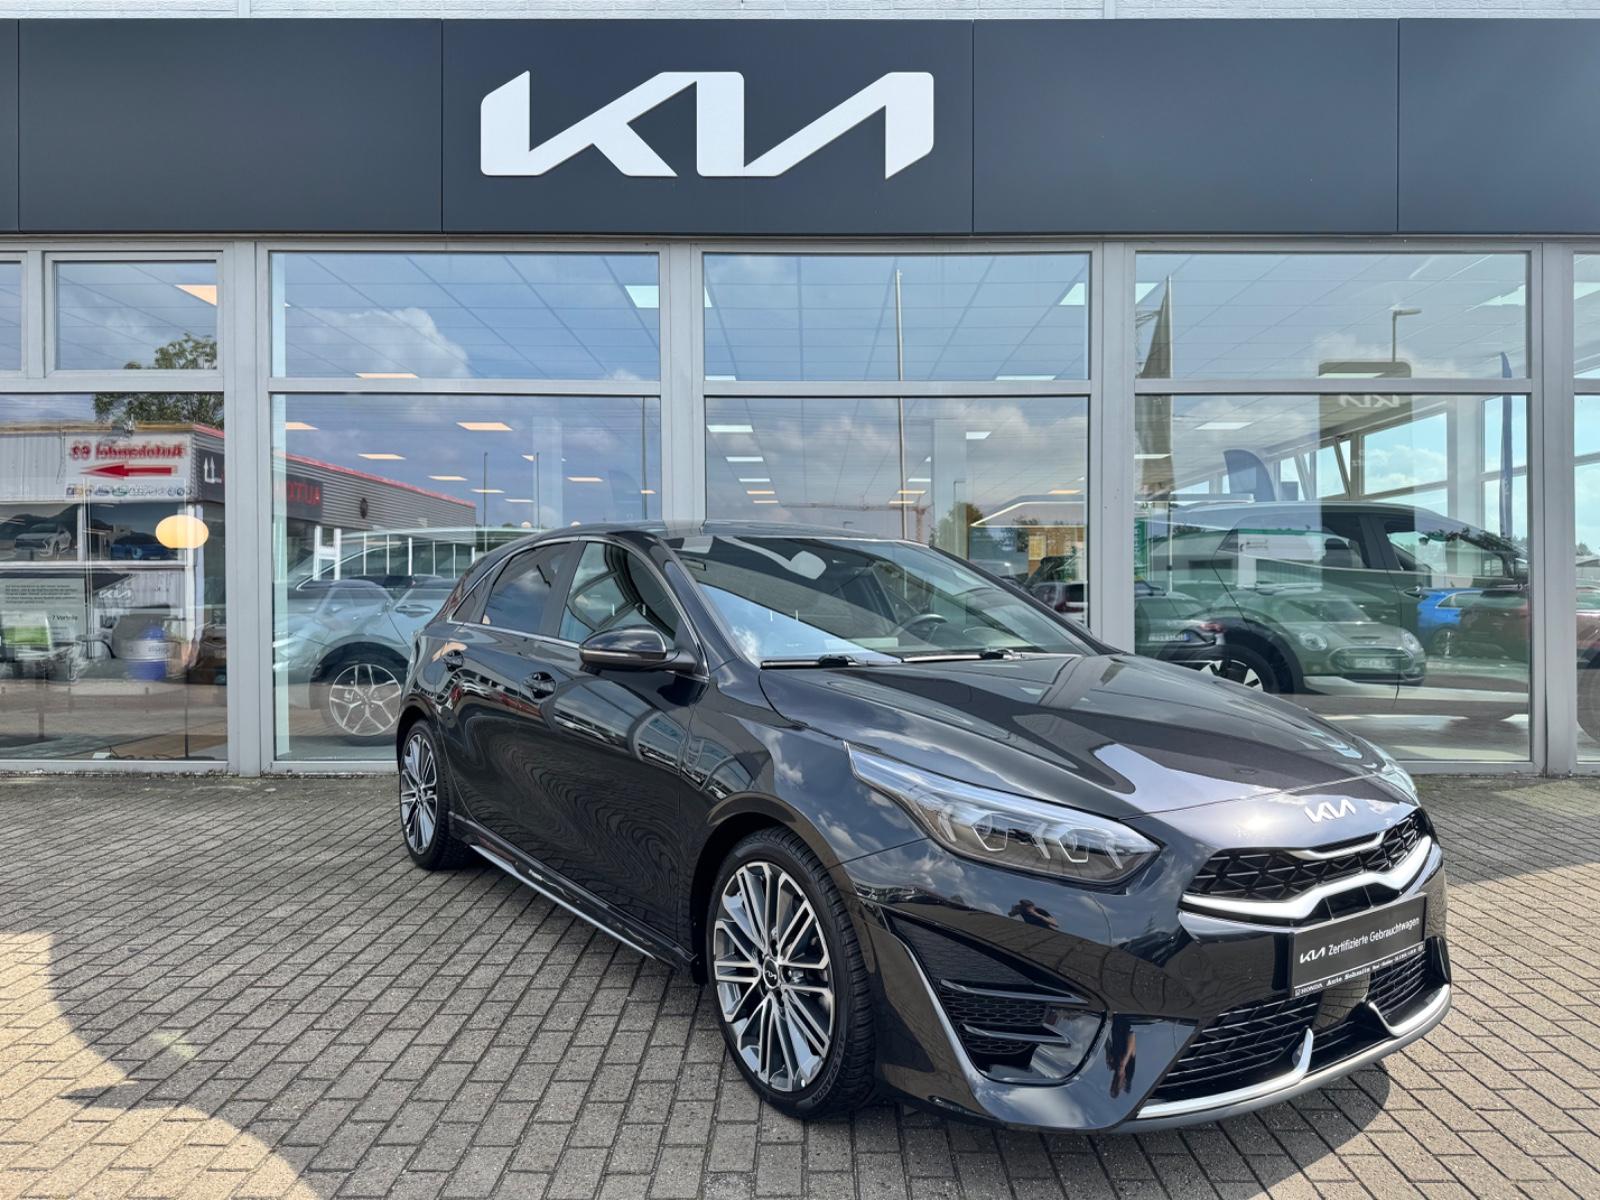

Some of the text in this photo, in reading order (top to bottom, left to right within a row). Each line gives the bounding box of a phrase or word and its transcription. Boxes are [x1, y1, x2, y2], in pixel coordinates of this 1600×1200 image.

[480, 70, 935, 179] KIA
[1304, 799, 1356, 824] KIA
[1299, 916, 1420, 964] KIA Zertifizierte Gebrauchtwagen
[811, 1060, 840, 1104] SEASON
